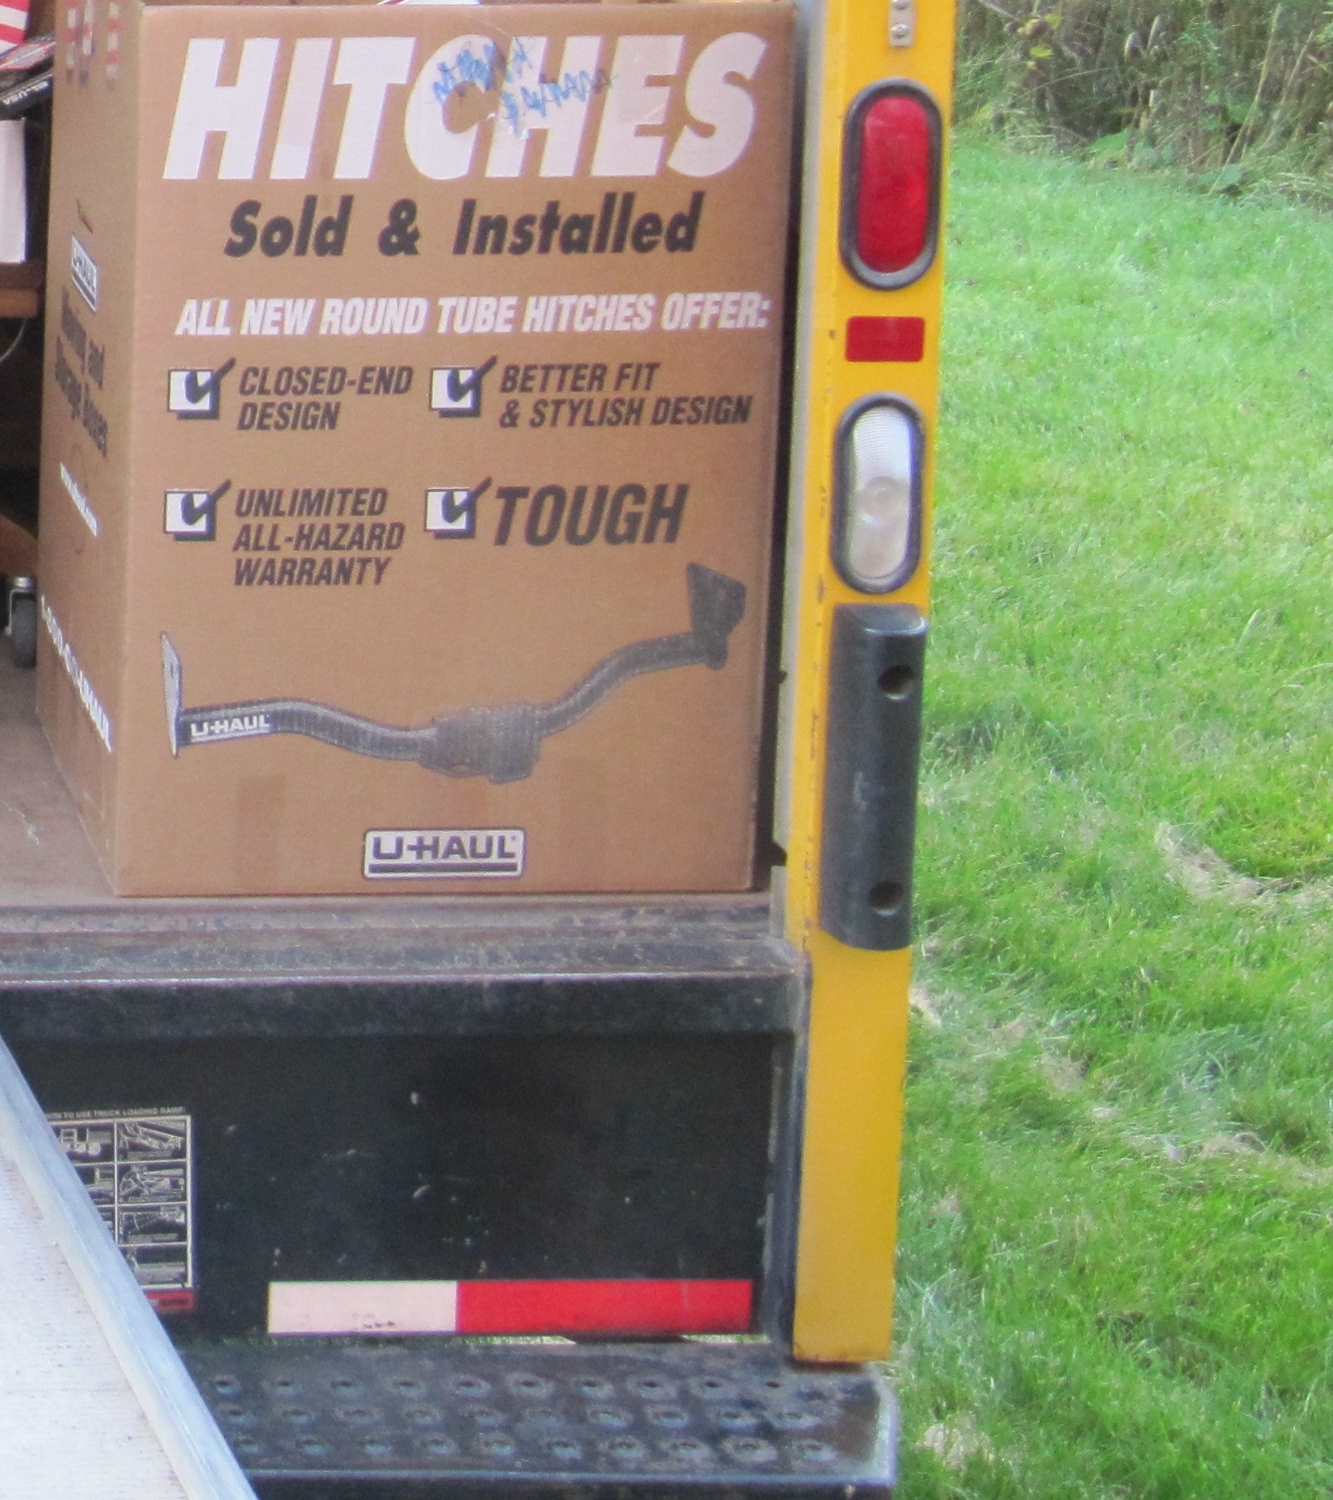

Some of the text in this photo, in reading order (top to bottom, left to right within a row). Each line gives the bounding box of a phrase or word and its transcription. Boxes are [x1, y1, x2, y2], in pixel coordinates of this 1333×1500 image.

[162, 33, 769, 181] HITCHES
[223, 190, 706, 258] Sold & Installed
[175, 291, 771, 336] ALL NEW ROUND TUBE HITCHES OFFER:
[239, 366, 414, 396] CLOSED-END
[499, 361, 661, 393] BETTER FIT
[237, 401, 341, 431] DESIGN
[498, 395, 753, 429] & STYLISH DESIGN
[235, 488, 389, 518] UNLIMITED
[493, 482, 691, 547] TOUGH
[232, 522, 406, 552] ALL-HAZARD
[234, 556, 392, 587] WARRANTY
[190, 713, 271, 738] U-HAUL
[372, 834, 517, 861] U-HAUL
